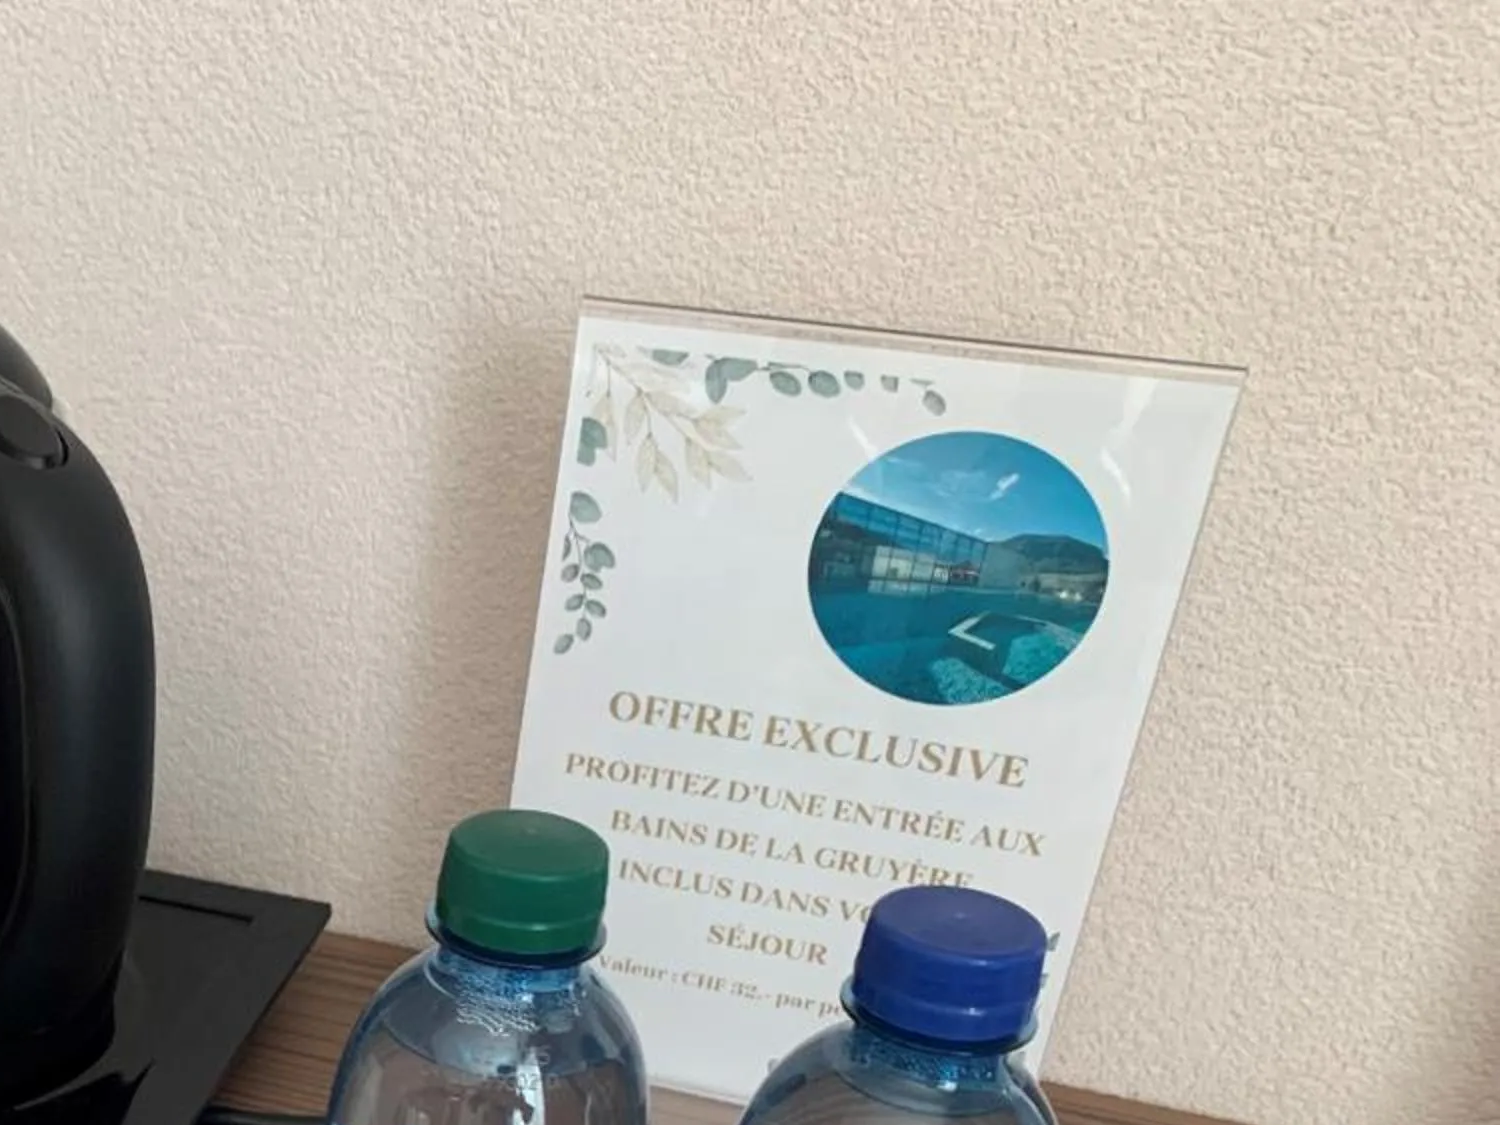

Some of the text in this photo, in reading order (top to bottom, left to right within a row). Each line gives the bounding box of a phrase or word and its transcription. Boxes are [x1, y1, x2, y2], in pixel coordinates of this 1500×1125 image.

[608, 689, 1031, 790] OFFRE EXCLUSIVE
[564, 752, 1047, 859] PROFITEZ D'UNE ENTRÉE AUX
[610, 809, 708, 848] BAINS
[715, 827, 757, 857] DE
[764, 836, 806, 865] LA
[618, 858, 734, 900] INCLUS
[739, 881, 830, 920] DANS
[706, 920, 829, 968] SÉJOUR
[681, 971, 727, 994] CHF
[775, 992, 817, 1011] par
